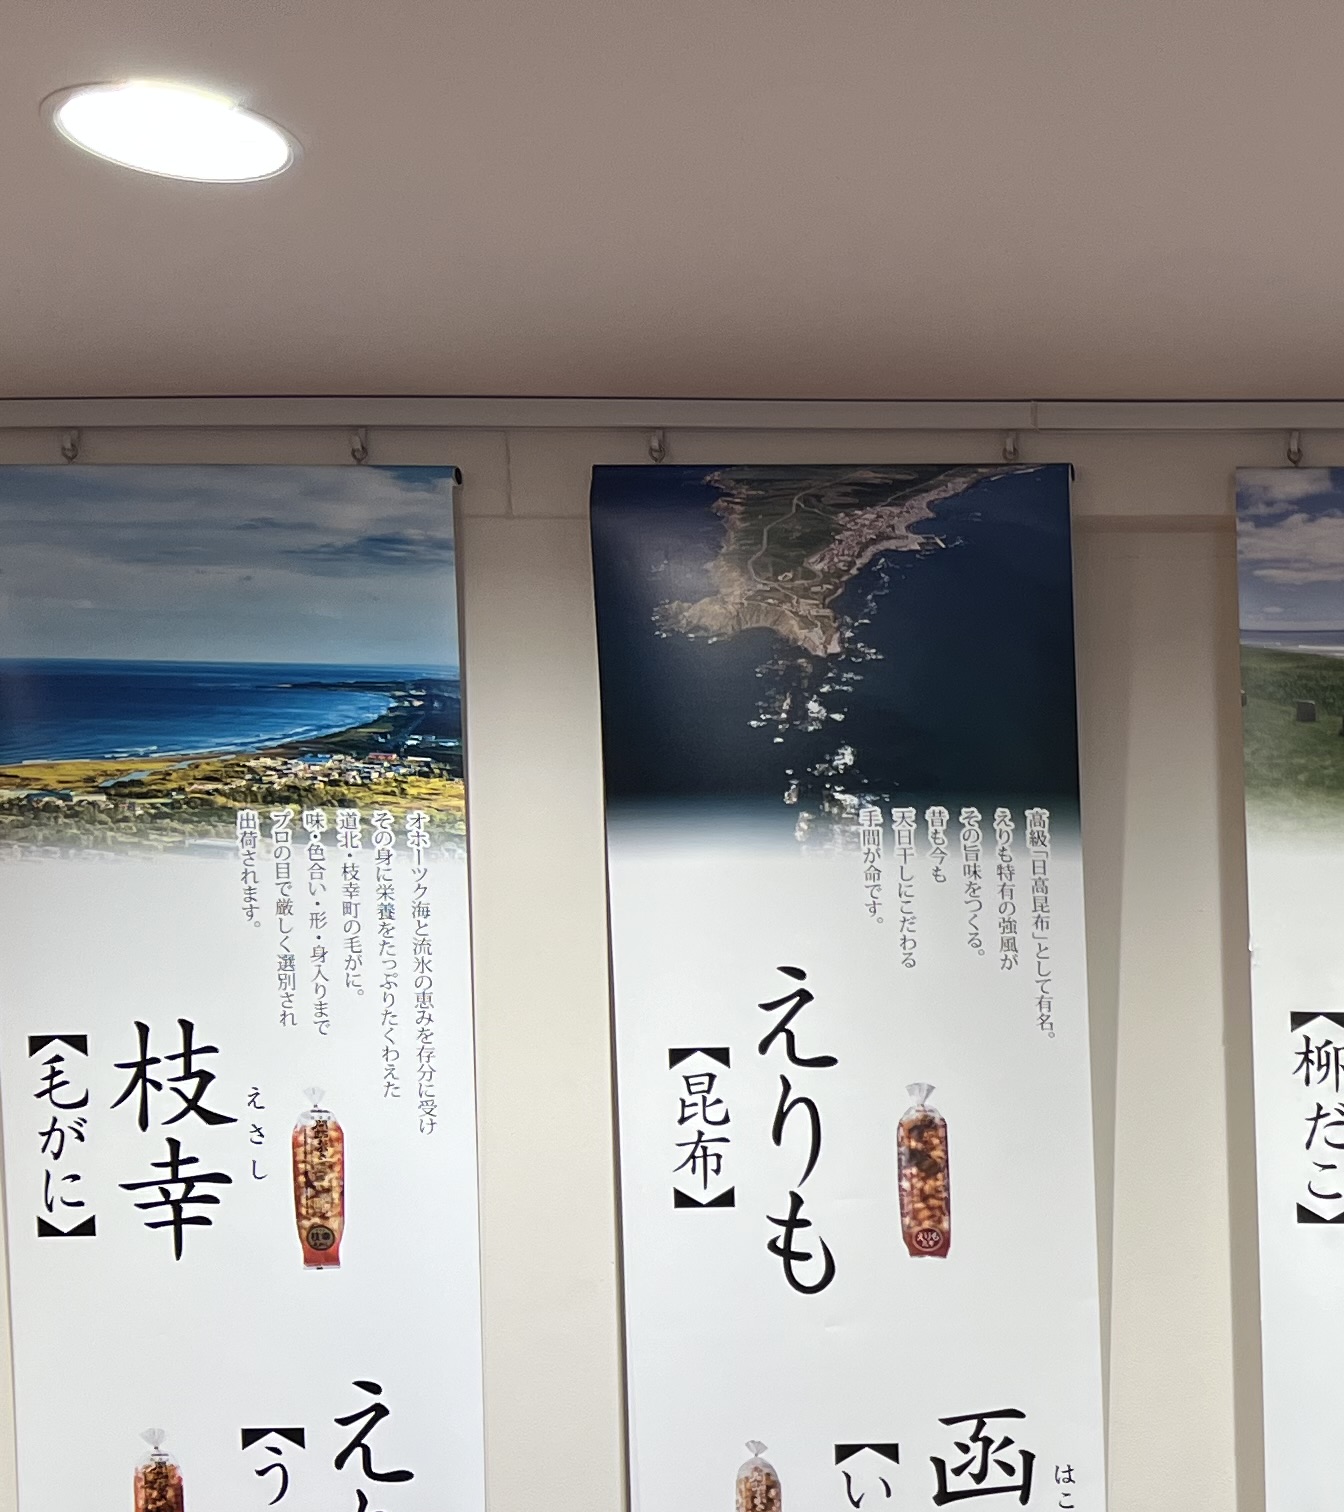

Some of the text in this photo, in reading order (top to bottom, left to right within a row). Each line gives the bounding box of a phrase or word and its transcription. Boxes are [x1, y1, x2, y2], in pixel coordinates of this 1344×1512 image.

[238, 812, 261, 928] 出荷されます。
[271, 812, 297, 1027] プロの目で厳しく選別され
[304, 812, 330, 1036] 味・色合い・形・身入りまで
[338, 812, 364, 996] 道北・枝幸町の毛がに。
[861, 810, 883, 923] 手間が命です。
[894, 809, 917, 968] 天日干しにこだわる
[927, 809, 947, 882] 昔も今も
[961, 809, 985, 956] その旨味をつくる。
[994, 809, 1018, 970] えりも特有の強風が
[1028, 808, 1055, 1039] 高級「日高昆布」として有名。
[372, 810, 401, 1099] その身に栄養をたっぷりたくわえた
[407, 810, 437, 1135] オホーツク海と流氷の恵みを存分に受け
[28, 1035, 96, 1237] 【毛がに】
[110, 1019, 238, 1260] 枝幸
[247, 1087, 268, 1181] えさし
[668, 1047, 735, 1208] 【昆布】
[758, 966, 838, 1294] えりも
